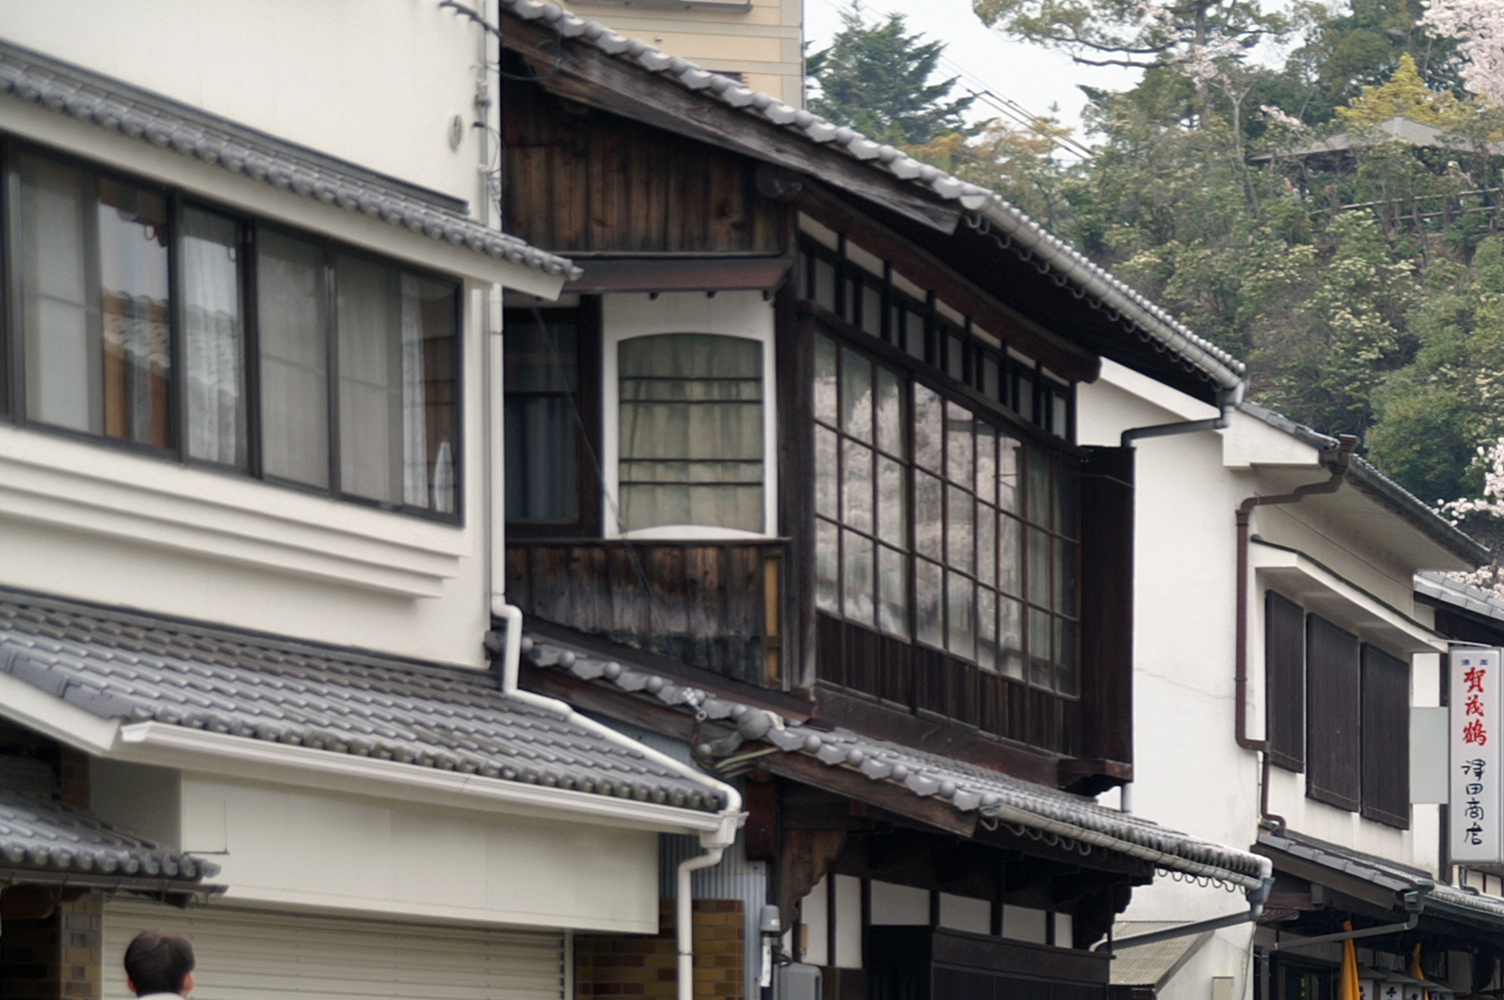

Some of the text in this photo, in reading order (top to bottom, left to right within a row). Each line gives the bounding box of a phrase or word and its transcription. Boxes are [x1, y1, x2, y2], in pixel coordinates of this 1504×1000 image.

[1460, 666, 1488, 846] 賀茂鶴 津田商店
